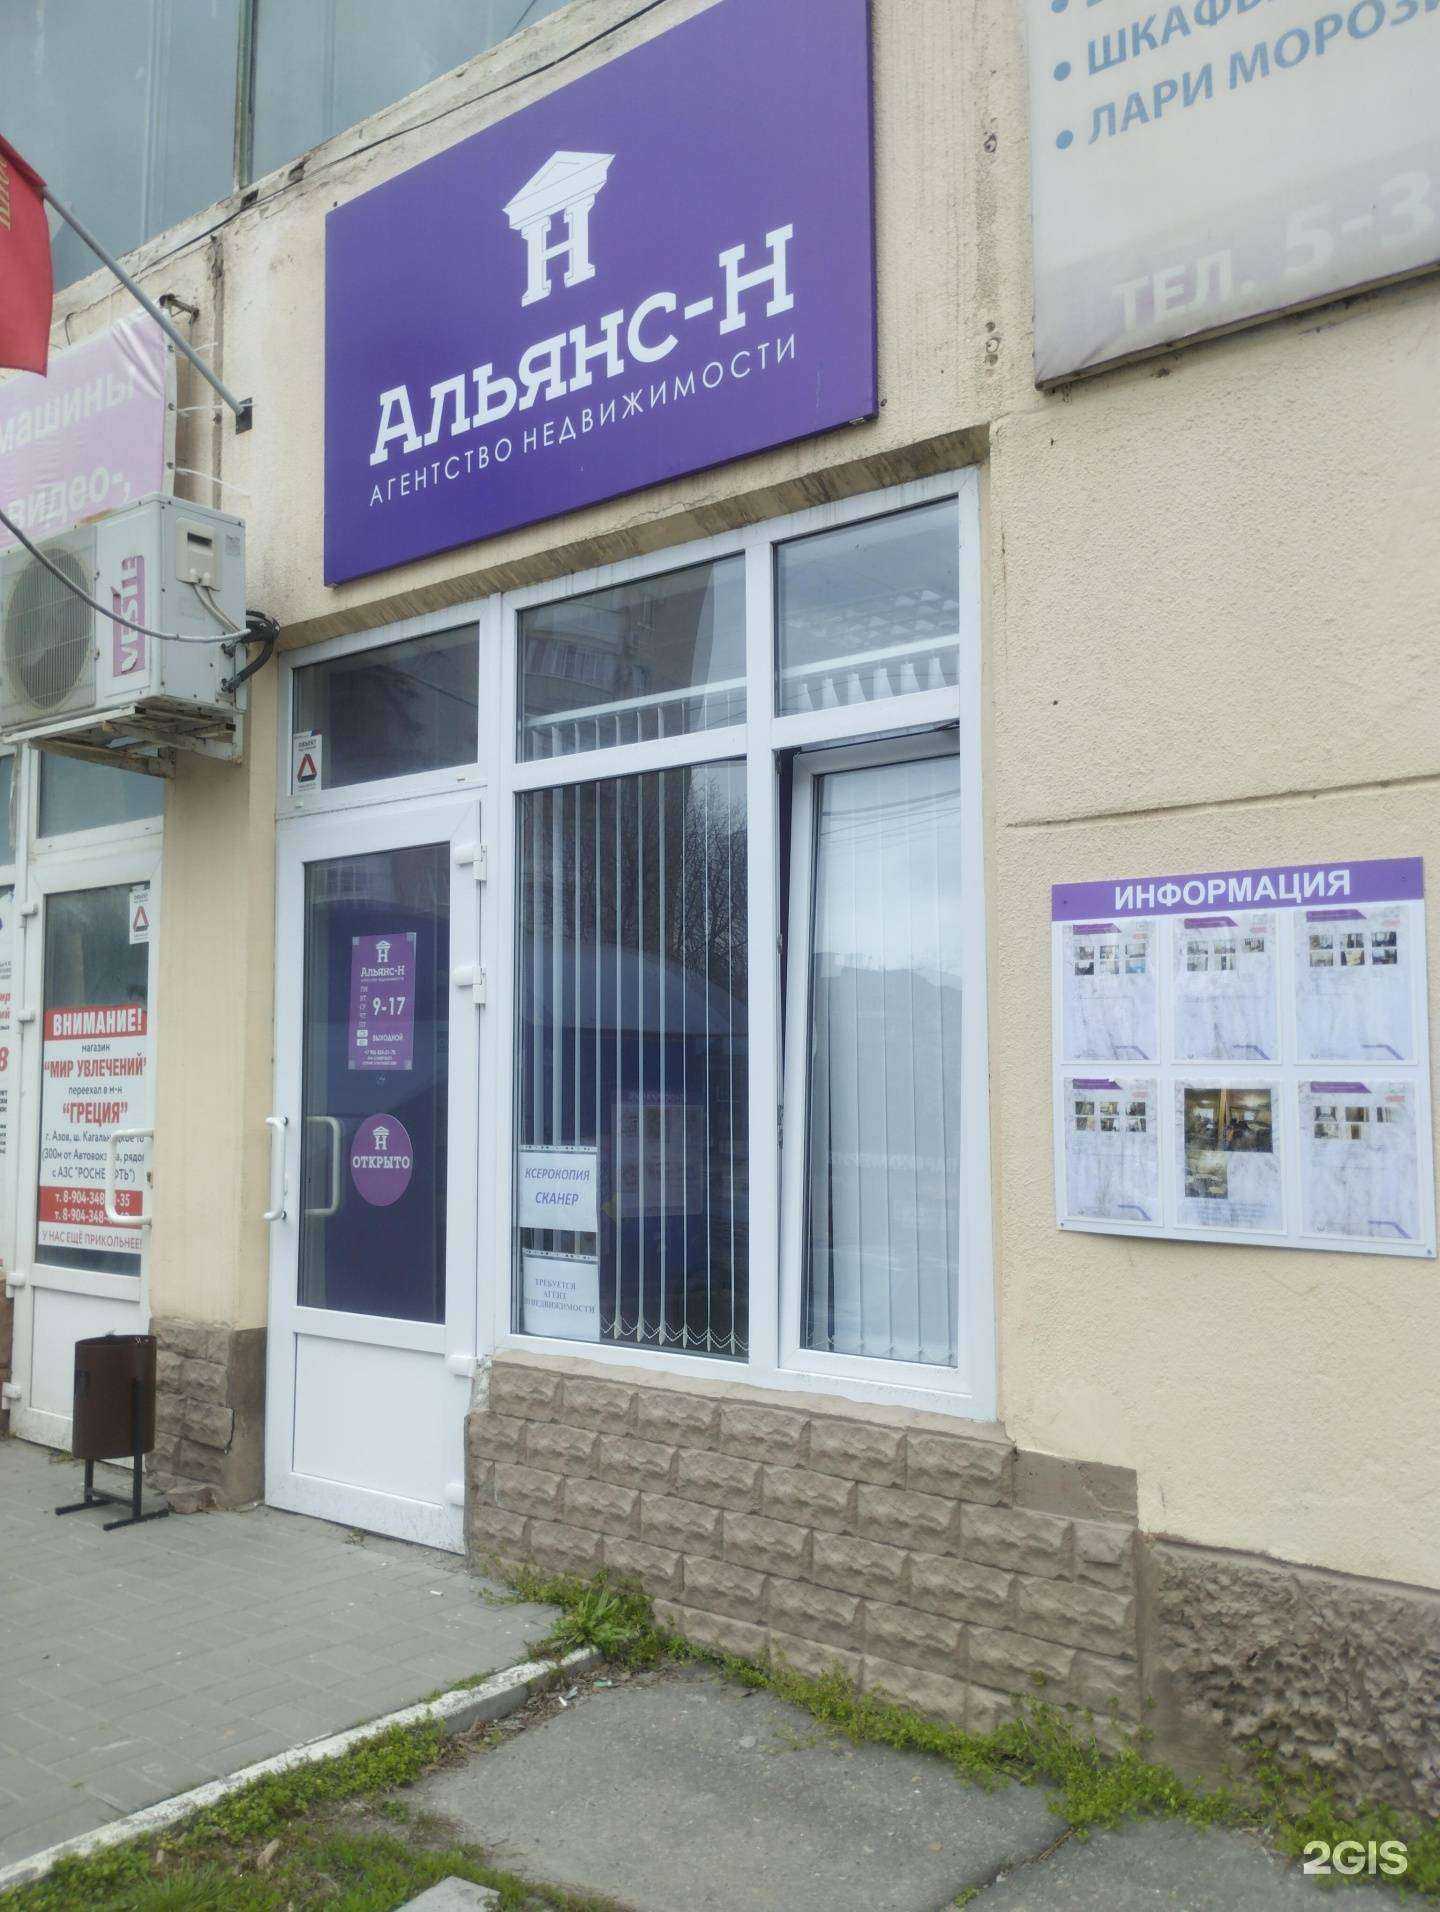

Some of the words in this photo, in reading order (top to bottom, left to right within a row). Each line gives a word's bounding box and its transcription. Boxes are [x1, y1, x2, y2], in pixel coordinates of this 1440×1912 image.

[1088, 63, 1214, 145] ЛАРИ
[1112, 248, 1257, 332] ТЕЛ.
[369, 438, 513, 507] АГЕНТСТВО
[523, 334, 796, 454] НЕДВИЖИМОСТИ
[1115, 869, 1351, 911] ИНФОРМАЦИЯ
[372, 996, 406, 1016] 9-17
[53, 1008, 142, 1036] ВНИМАНИЕ!
[57, 1167, 74, 1178] АЗС
[352, 1156, 411, 1169] ОТКРЫТО
[525, 1168, 590, 1181] КСЕРОКОПИЯ
[535, 1191, 579, 1206] СКАНЕР
[48, 1231, 66, 1243] НАС
